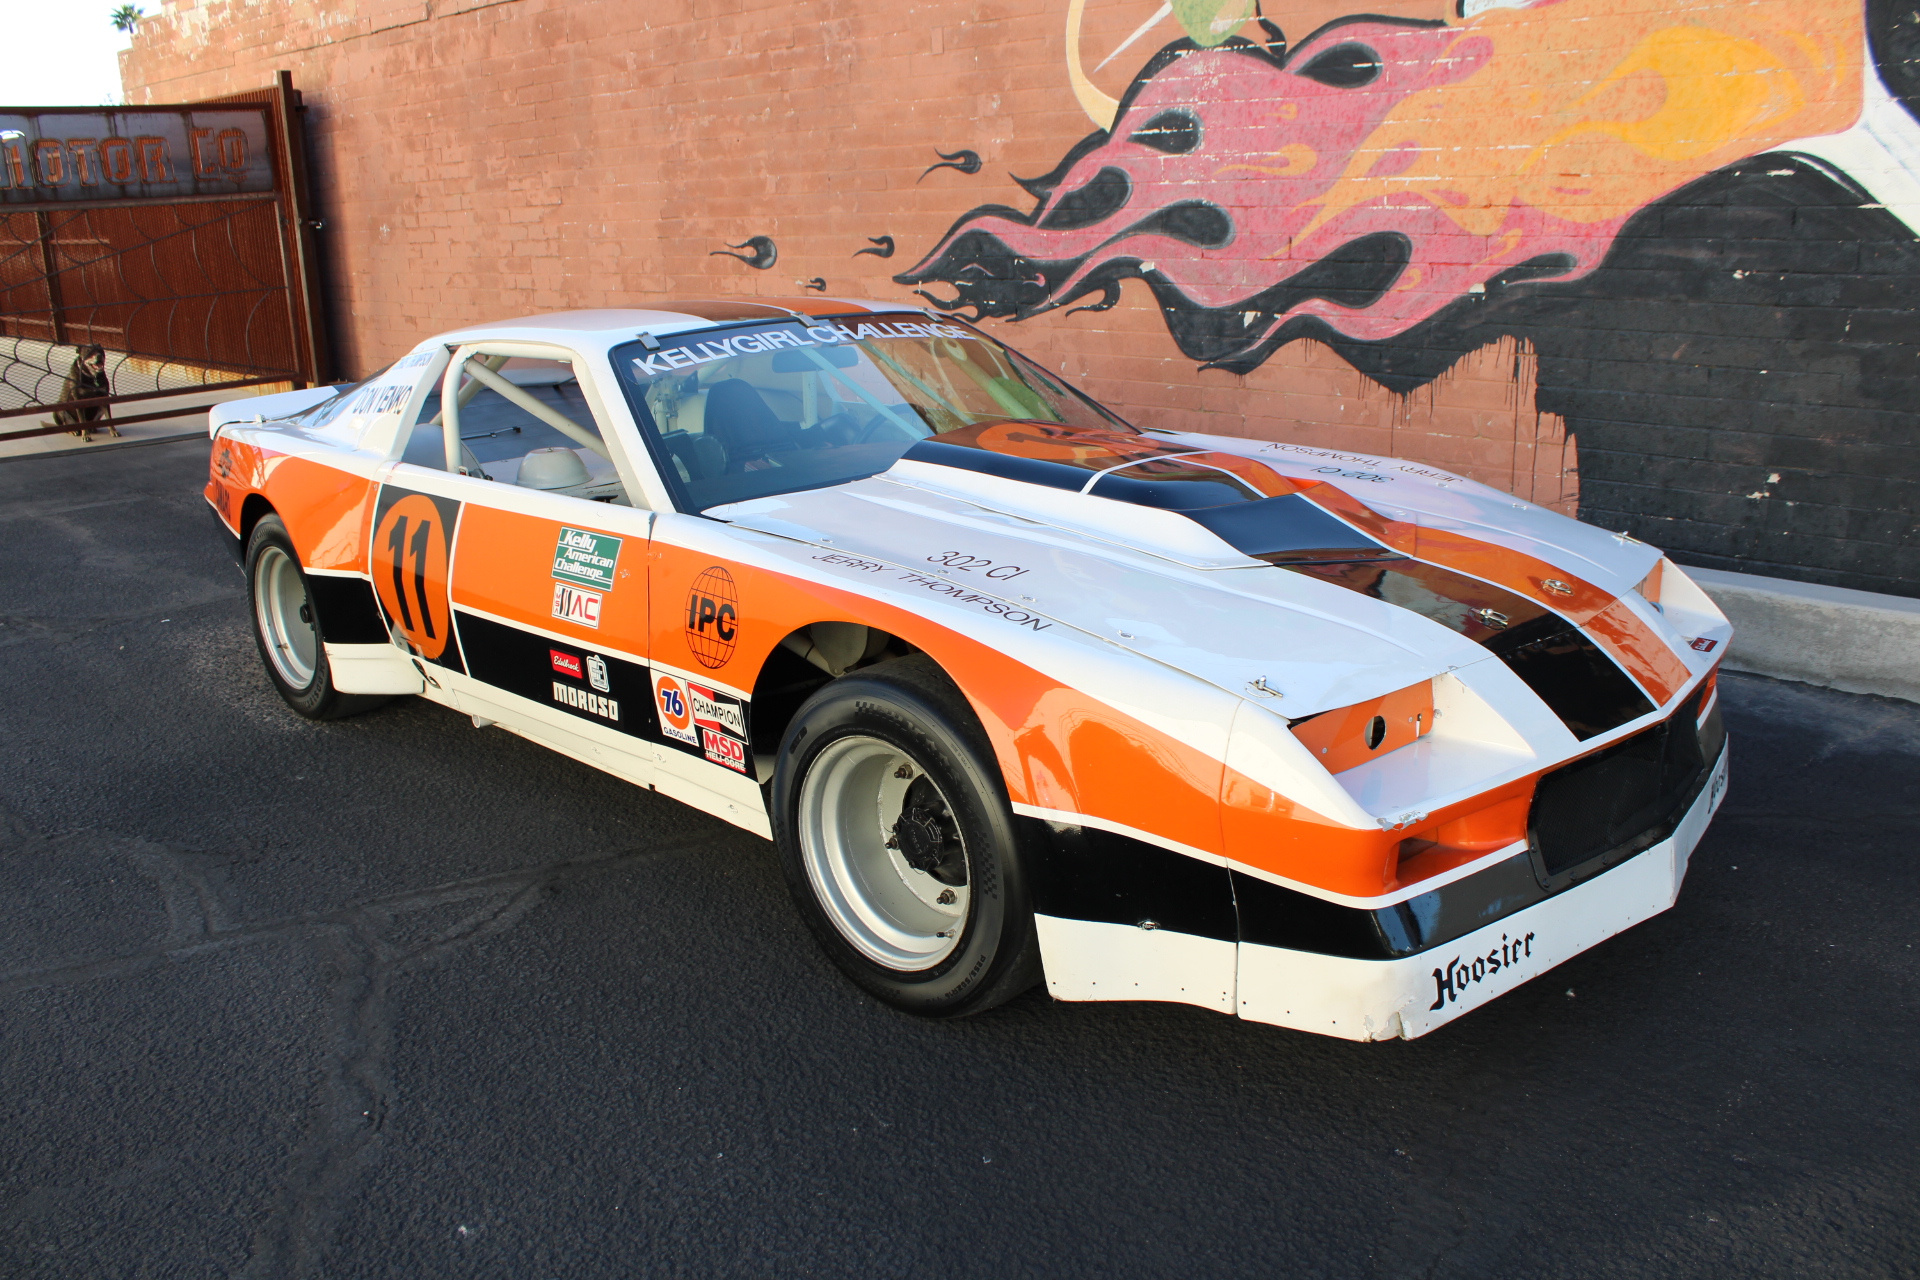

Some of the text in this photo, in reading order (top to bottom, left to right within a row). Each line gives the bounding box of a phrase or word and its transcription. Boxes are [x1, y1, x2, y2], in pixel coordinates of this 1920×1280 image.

[631, 322, 977, 376] KELLYGIRL CHALLENGE
[352, 385, 414, 415] DON YENKO
[1265, 442, 1463, 483] JERRY THOMPSON
[1341, 470, 1394, 484] 302
[563, 530, 598, 553] Kelly
[554, 557, 604, 580] Challenge
[564, 548, 614, 568] American
[927, 551, 1030, 581] 302 CI
[387, 515, 437, 641] 11
[812, 553, 1053, 631] JERRY THOMPSON
[689, 594, 736, 641] IPC
[552, 681, 619, 722] MOROSO
[661, 689, 684, 717] 76
[692, 698, 741, 728] CHAMPION
[663, 726, 697, 744] GASOLINE
[703, 730, 743, 761] MSD
[1429, 931, 1535, 1012] Hoosier
